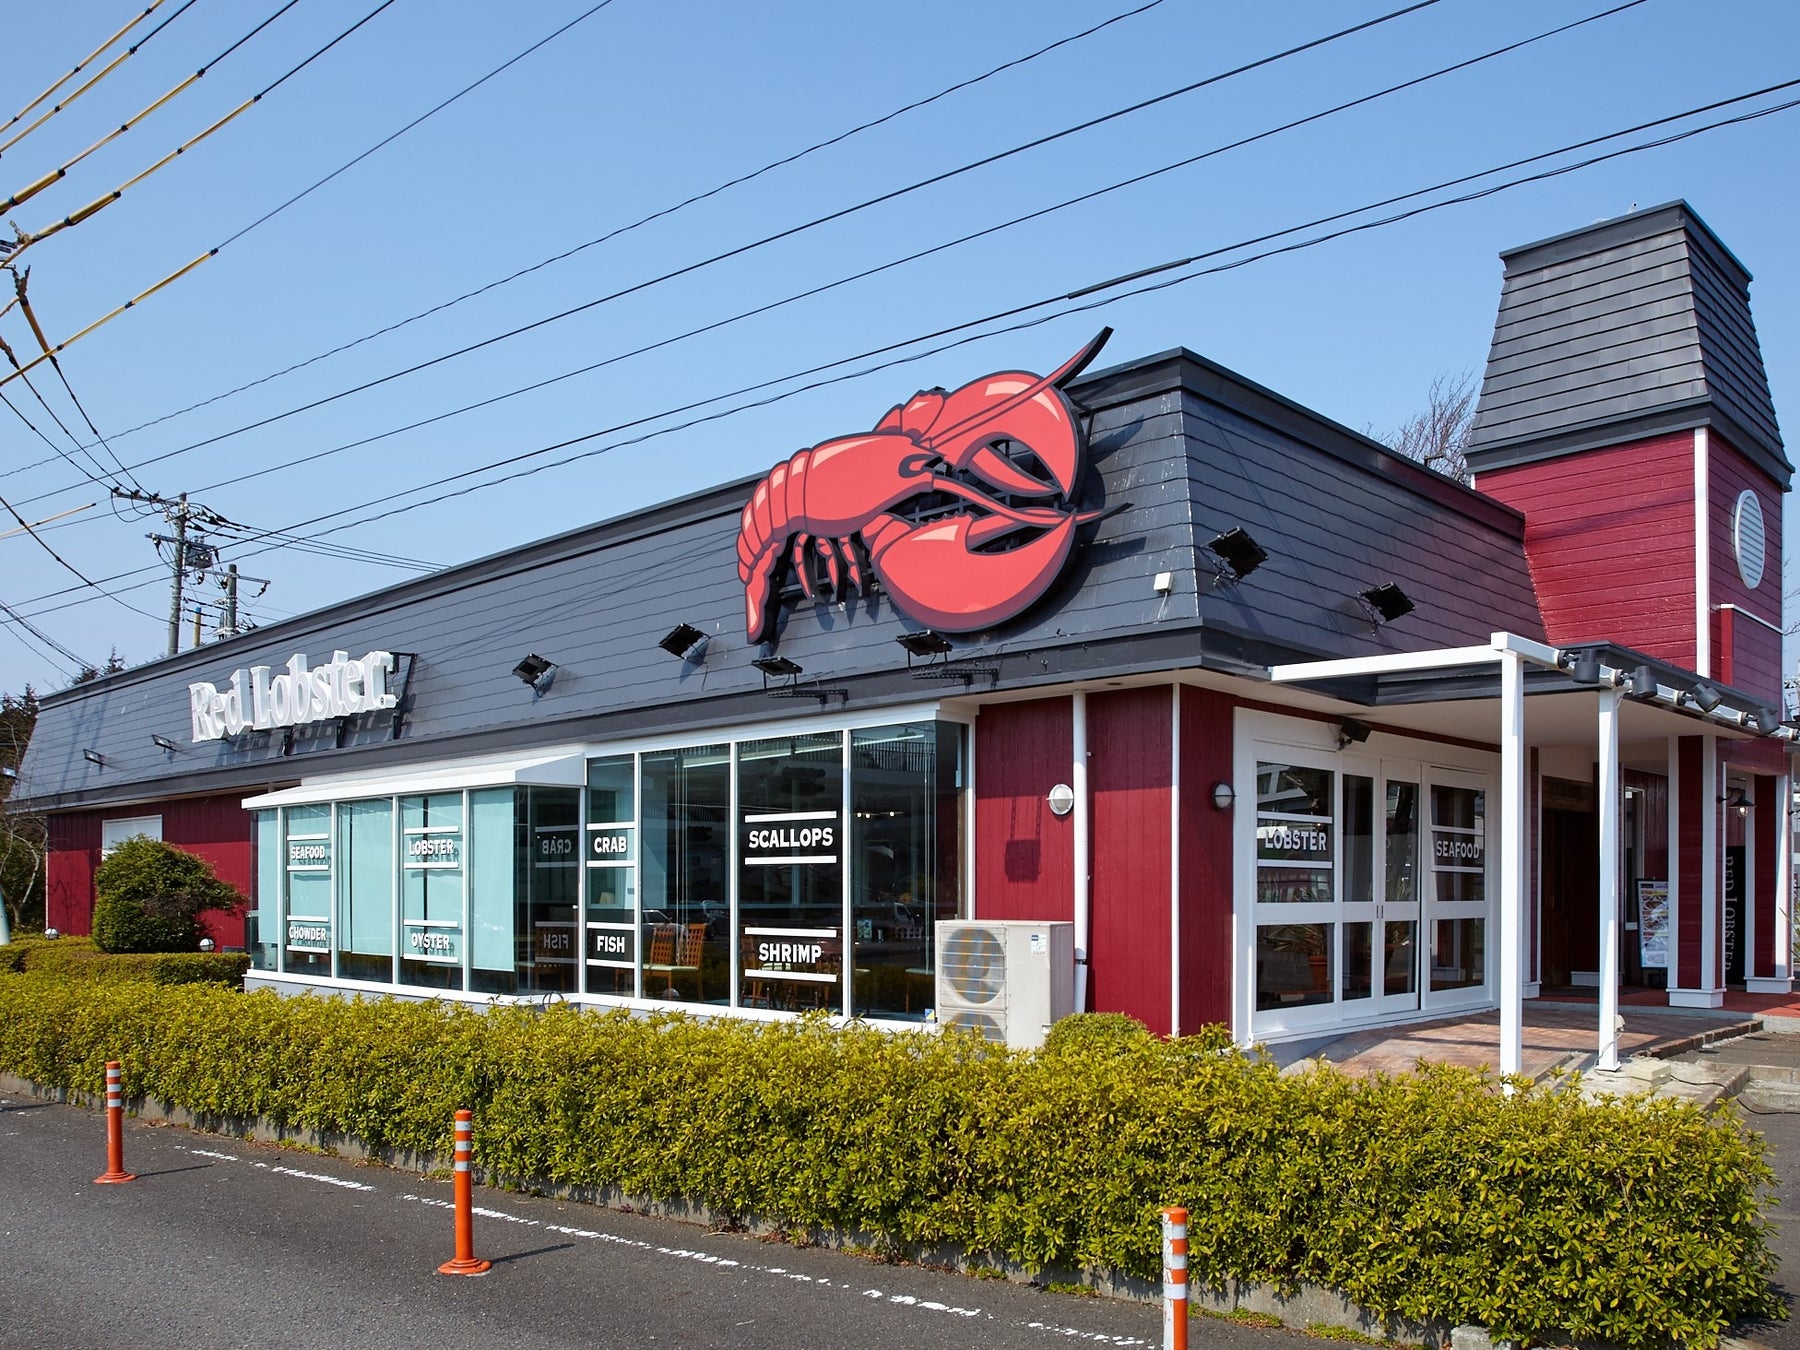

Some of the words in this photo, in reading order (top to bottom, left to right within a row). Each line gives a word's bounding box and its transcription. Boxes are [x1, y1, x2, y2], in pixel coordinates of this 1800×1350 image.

[188, 668, 252, 743] Red
[408, 838, 454, 856] LOBSTER
[594, 836, 627, 853] CRAB
[748, 827, 834, 849] SCALLOPS
[1264, 830, 1327, 851] LOBSTER
[290, 844, 325, 860] SEAFOOD
[1436, 840, 1480, 859] SEAFOOD
[288, 926, 327, 941] CHOWDER
[411, 933, 450, 949] OYSTER
[597, 935, 625, 953] FISH
[758, 942, 822, 964] SHRIMP
